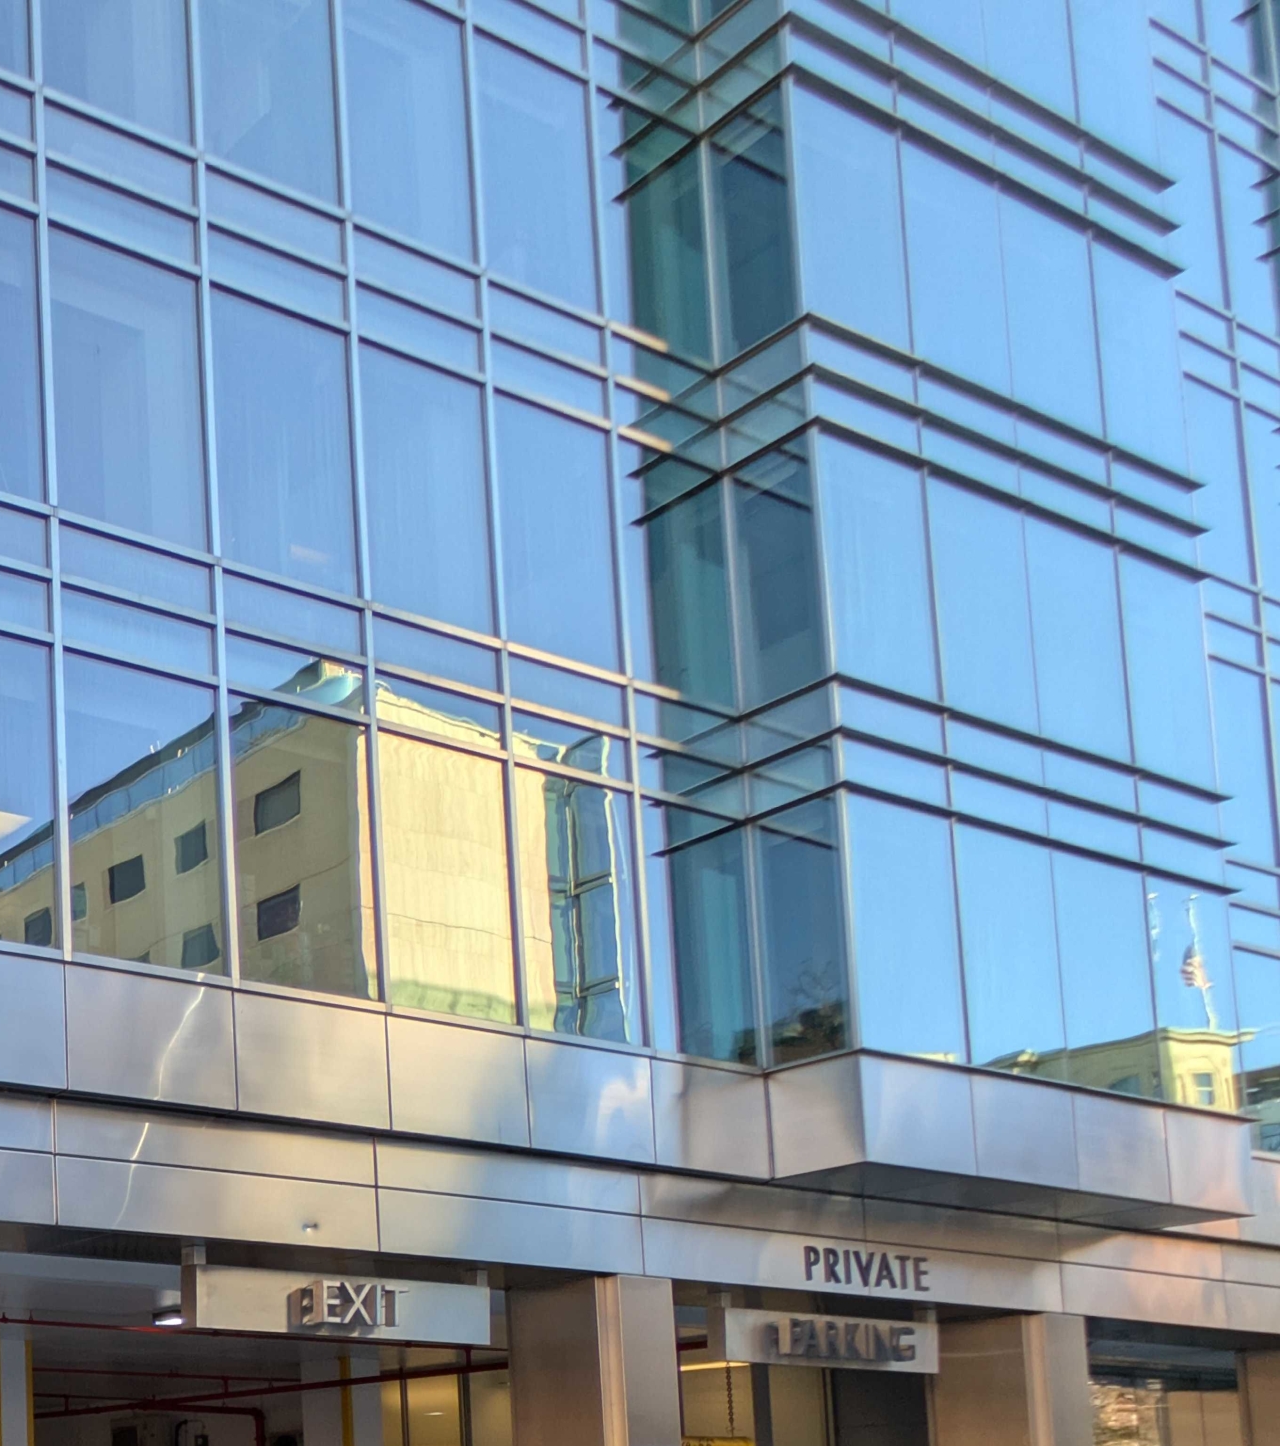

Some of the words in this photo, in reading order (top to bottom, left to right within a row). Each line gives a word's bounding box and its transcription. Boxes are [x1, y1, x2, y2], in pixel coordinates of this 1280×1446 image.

[802, 1245, 931, 1293] PRIVATE
[320, 1279, 411, 1328] EXIT
[776, 1316, 917, 1363] PARKING
